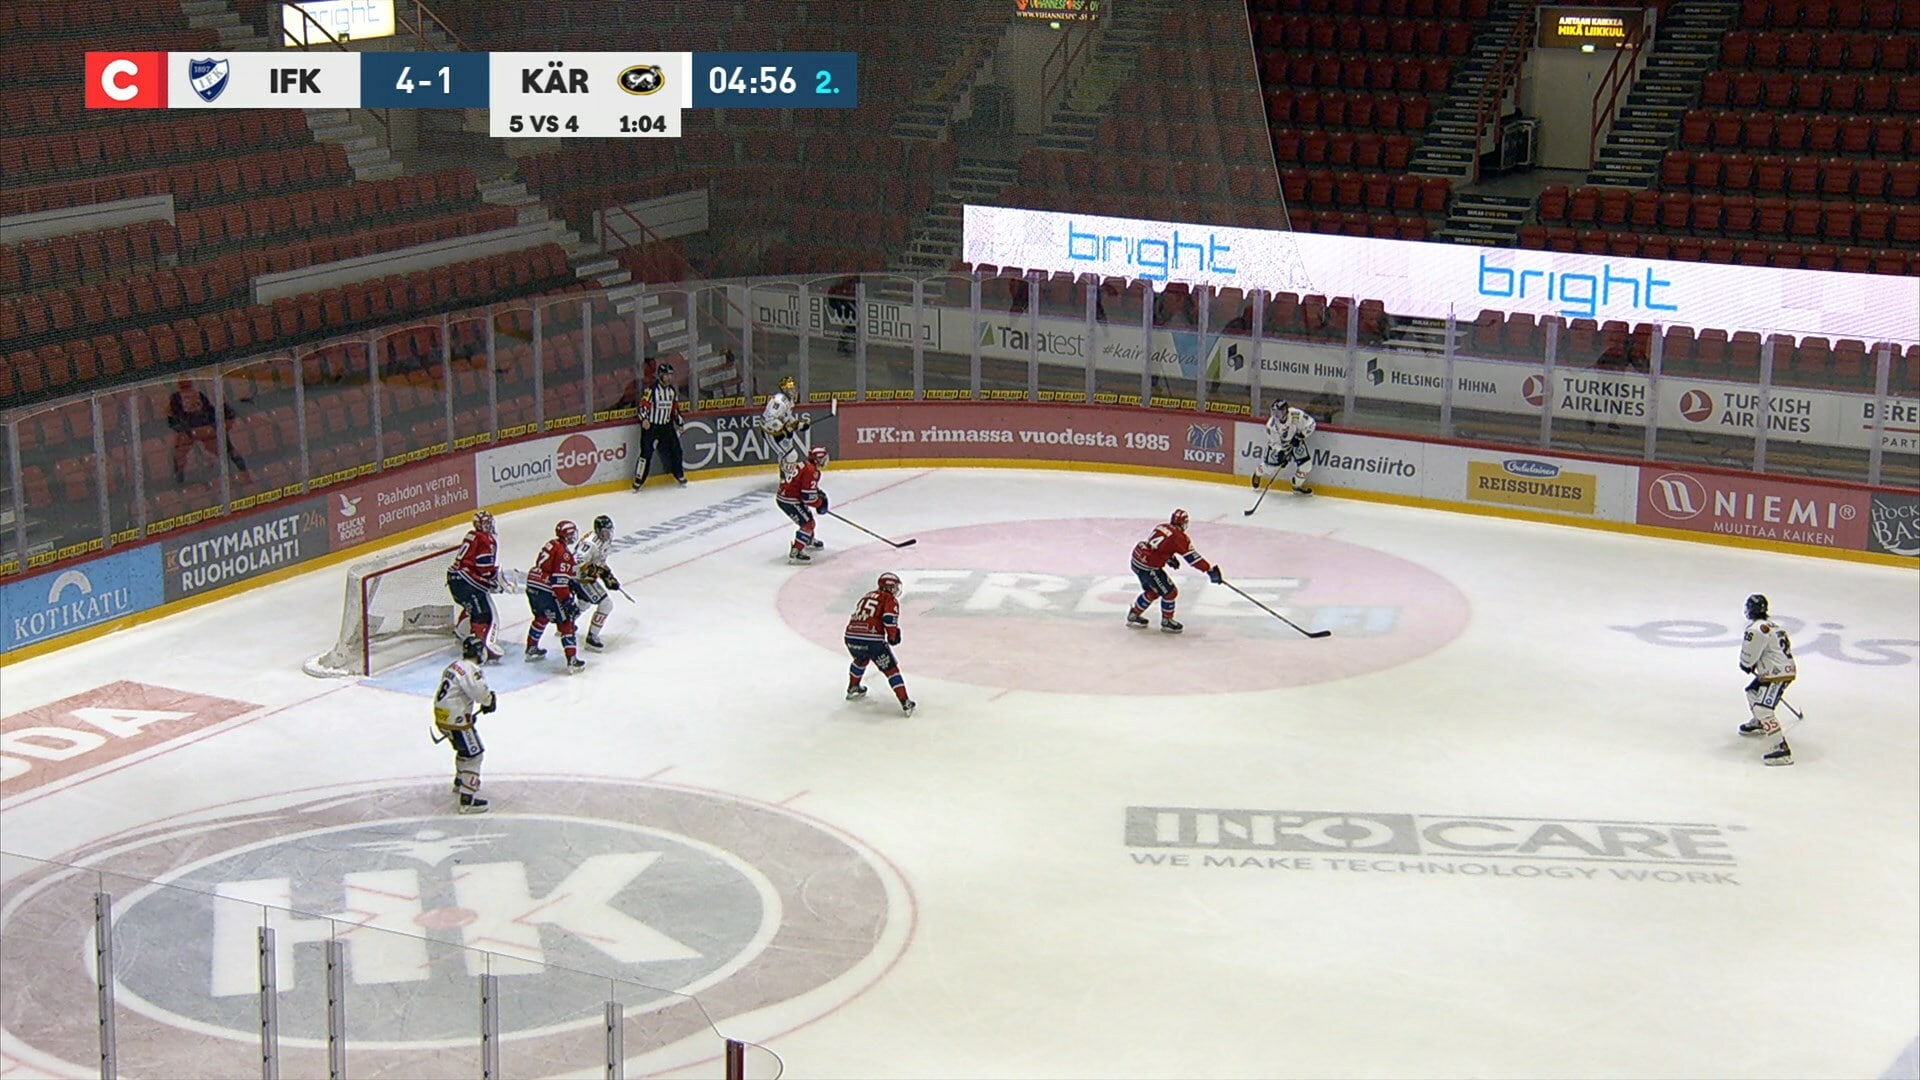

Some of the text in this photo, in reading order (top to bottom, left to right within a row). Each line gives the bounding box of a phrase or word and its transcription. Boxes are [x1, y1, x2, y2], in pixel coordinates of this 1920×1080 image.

[1068, 220, 1237, 281] bright
[1479, 255, 1678, 318] bright
[1563, 378, 1645, 400] TURKISH
[1561, 395, 1645, 417] AIRLINES
[920, 427, 1013, 443] rinnassa
[1018, 428, 1117, 447] vuodesta
[1123, 433, 1170, 451] 1985
[492, 455, 551, 483] Lounari
[556, 443, 627, 469] Edenred
[1183, 449, 1226, 464] KOFF
[1312, 449, 1416, 477] Maansiirto
[377, 473, 460, 507] Paahdon verran
[1479, 476, 1582, 500] REISSUMIES
[379, 487, 468, 529] parempaa kahvia
[179, 515, 299, 567] CITYMARKET
[1713, 522, 1834, 545] MUUTTAA KAIKEN
[182, 539, 299, 591] RUOHOLAHTI
[14, 587, 128, 640] KOTIKATU
[1130, 852, 1741, 885] WE MAKE TECHNOLOGY WORK
